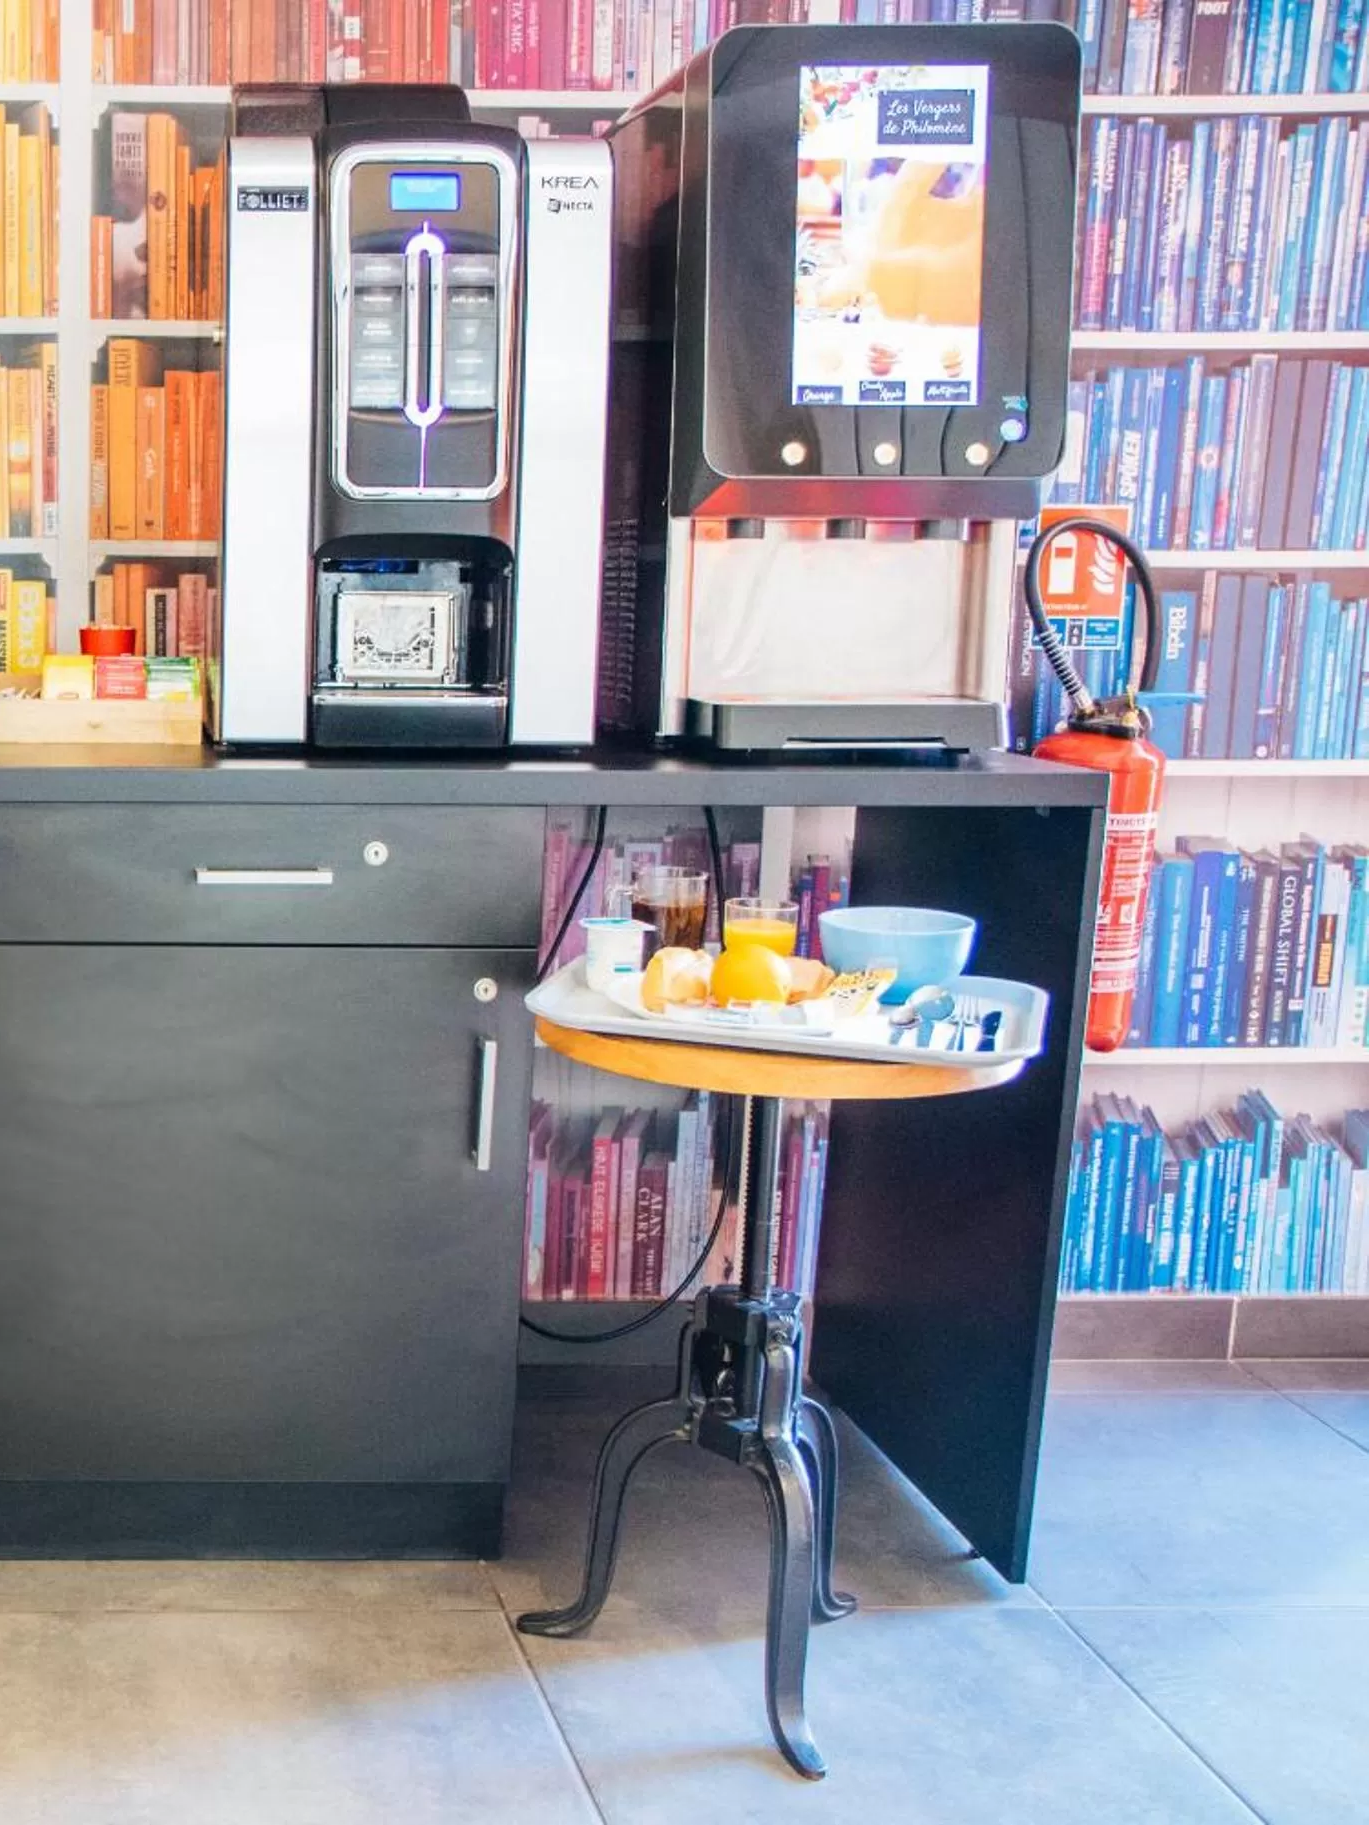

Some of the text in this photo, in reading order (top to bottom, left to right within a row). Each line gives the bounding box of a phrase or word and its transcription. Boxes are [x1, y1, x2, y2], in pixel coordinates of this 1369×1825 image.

[882, 119, 966, 137] de Philomène
[886, 99, 962, 121] Les Vergers
[540, 175, 600, 190] KREA
[1166, 605, 1188, 660] Bibeln
[1278, 875, 1297, 936] GLOBAL
[1273, 939, 1291, 986] SHIFT
[635, 1186, 652, 1243] CLARK
[648, 1191, 664, 1237] ALAN
